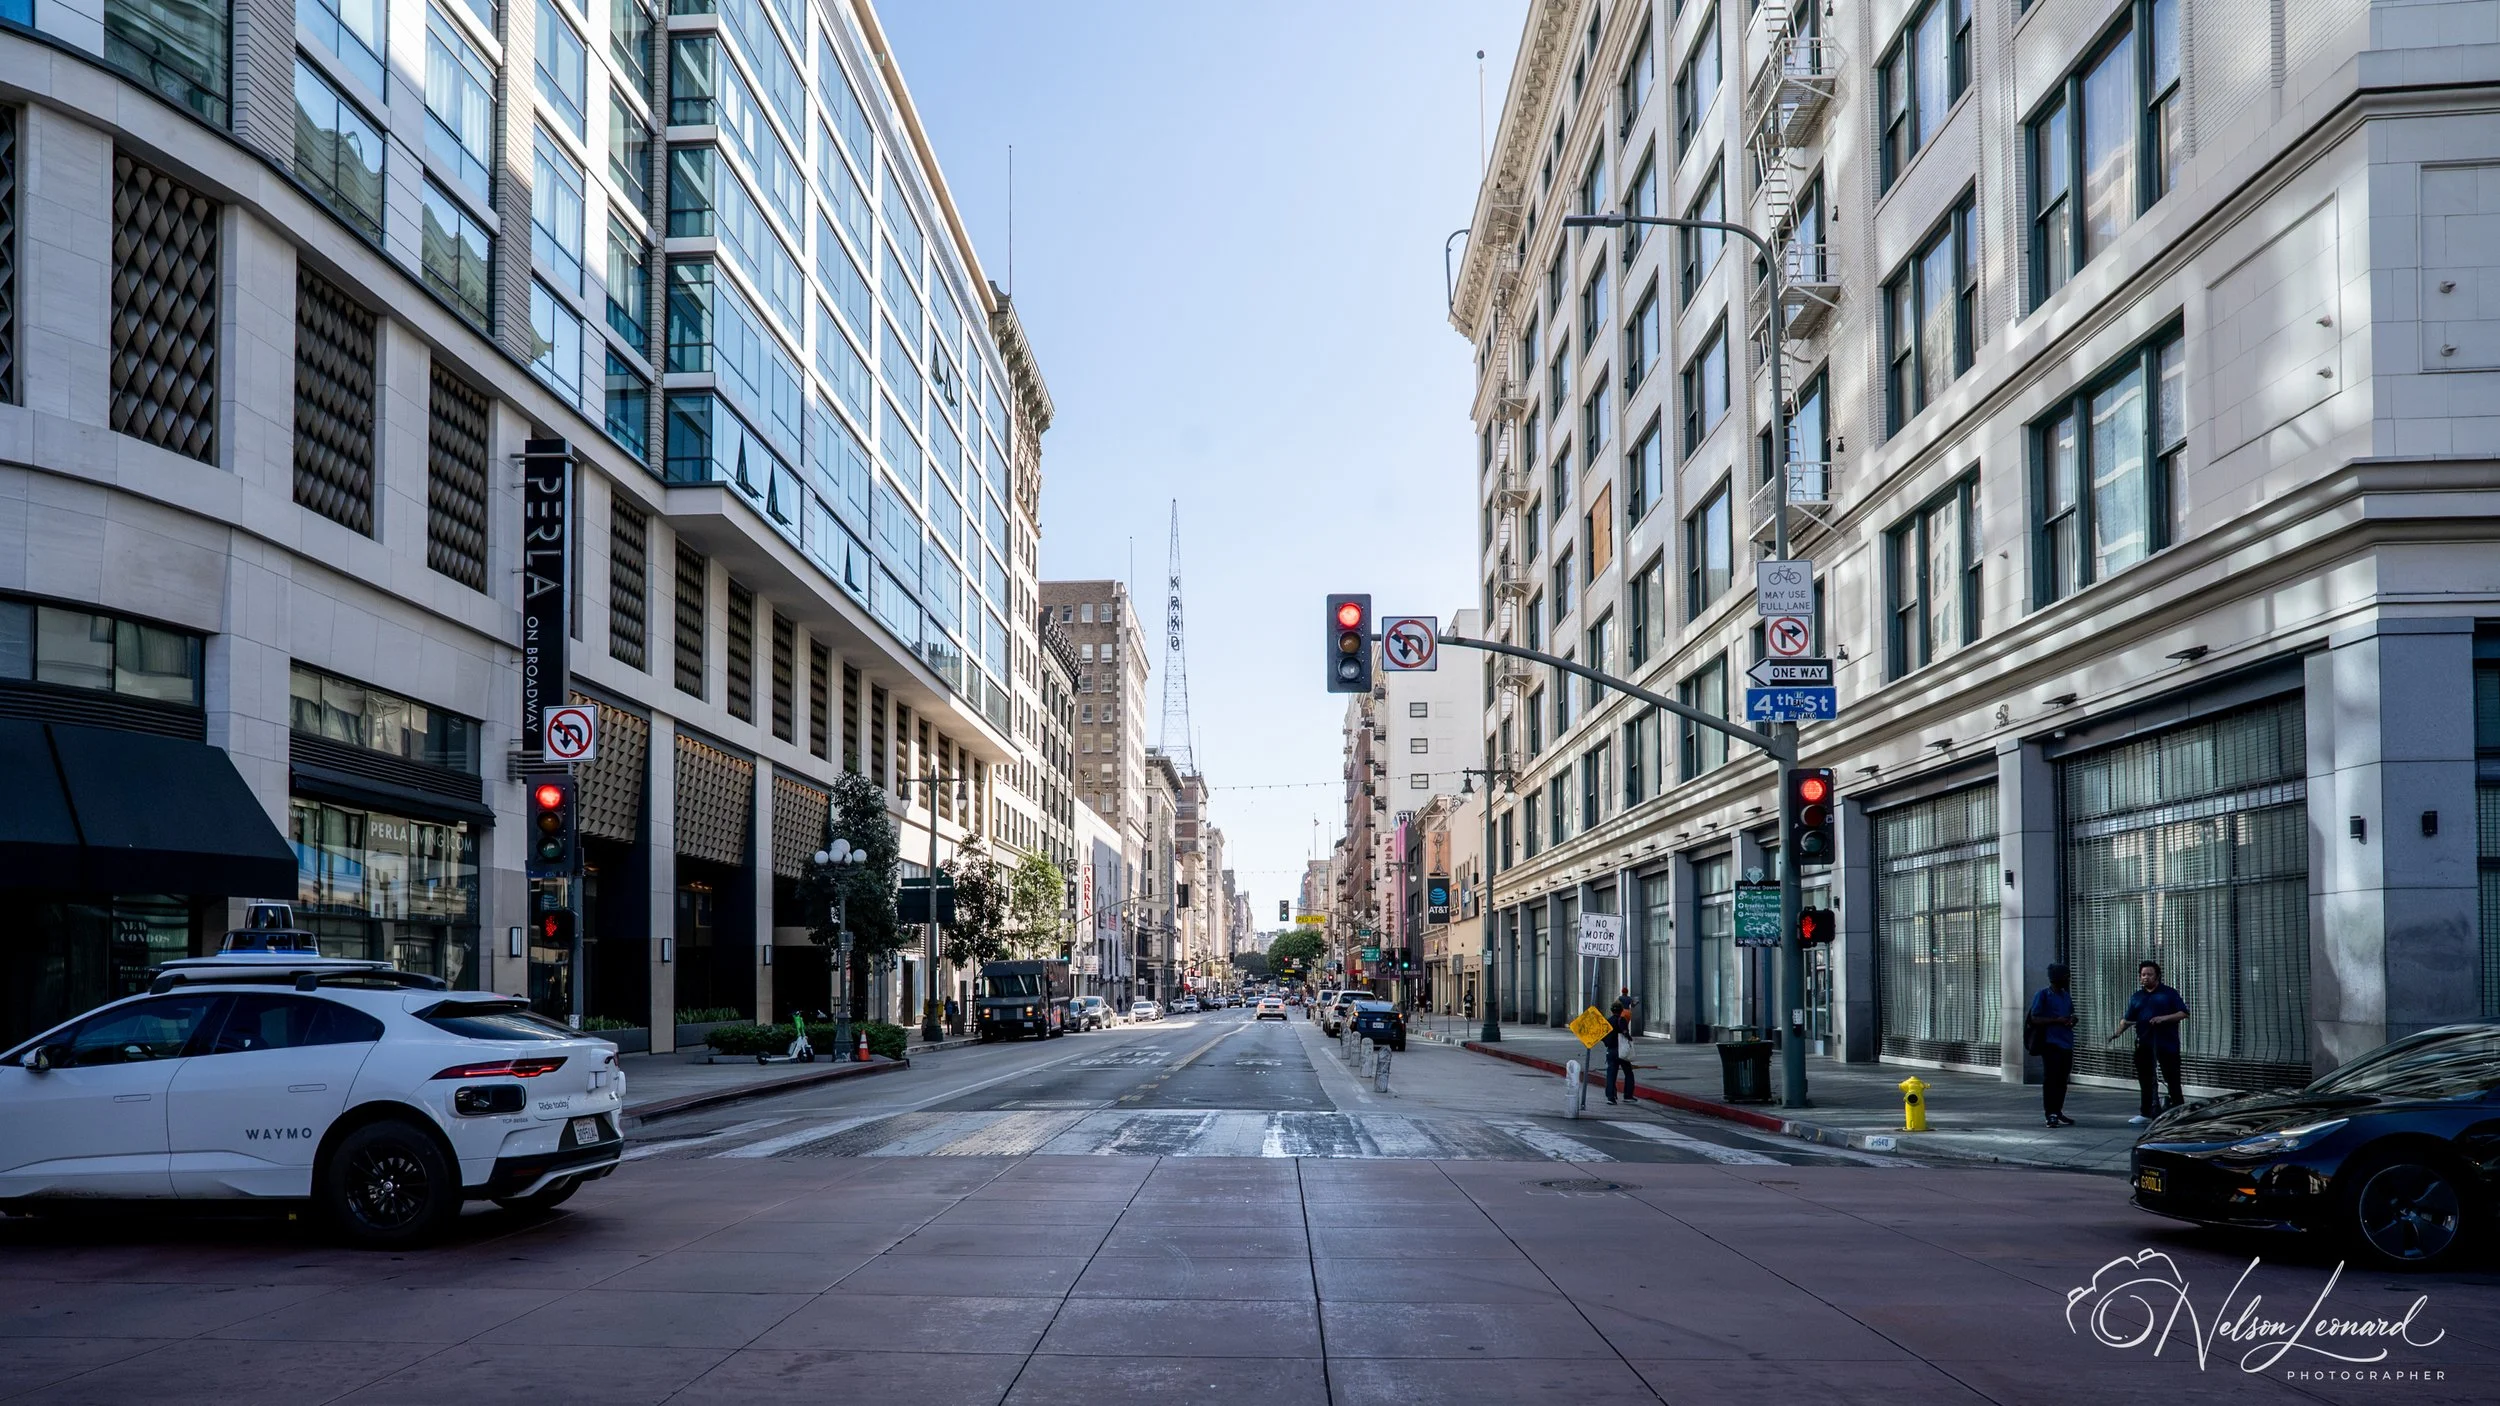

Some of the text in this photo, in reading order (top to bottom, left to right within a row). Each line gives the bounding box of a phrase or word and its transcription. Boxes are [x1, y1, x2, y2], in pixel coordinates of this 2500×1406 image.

[526, 476, 562, 601] PERLA
[1765, 590, 1806, 599] MAY USE
[1761, 601, 1811, 611] FULL LANE
[526, 616, 539, 734] ON BROADWAY
[1772, 667, 1825, 678] ONE WAY
[1804, 695, 1828, 712] St
[1083, 866, 1091, 926] PARKIN
[1428, 905, 1449, 914] AT&T
[121, 921, 147, 930] NEW
[1595, 919, 1607, 928] NO
[120, 933, 170, 942] CONDOS
[1586, 930, 1615, 940] MOTOR
[538, 1102, 553, 1110] Ride
[245, 1127, 312, 1140] WAYMO
